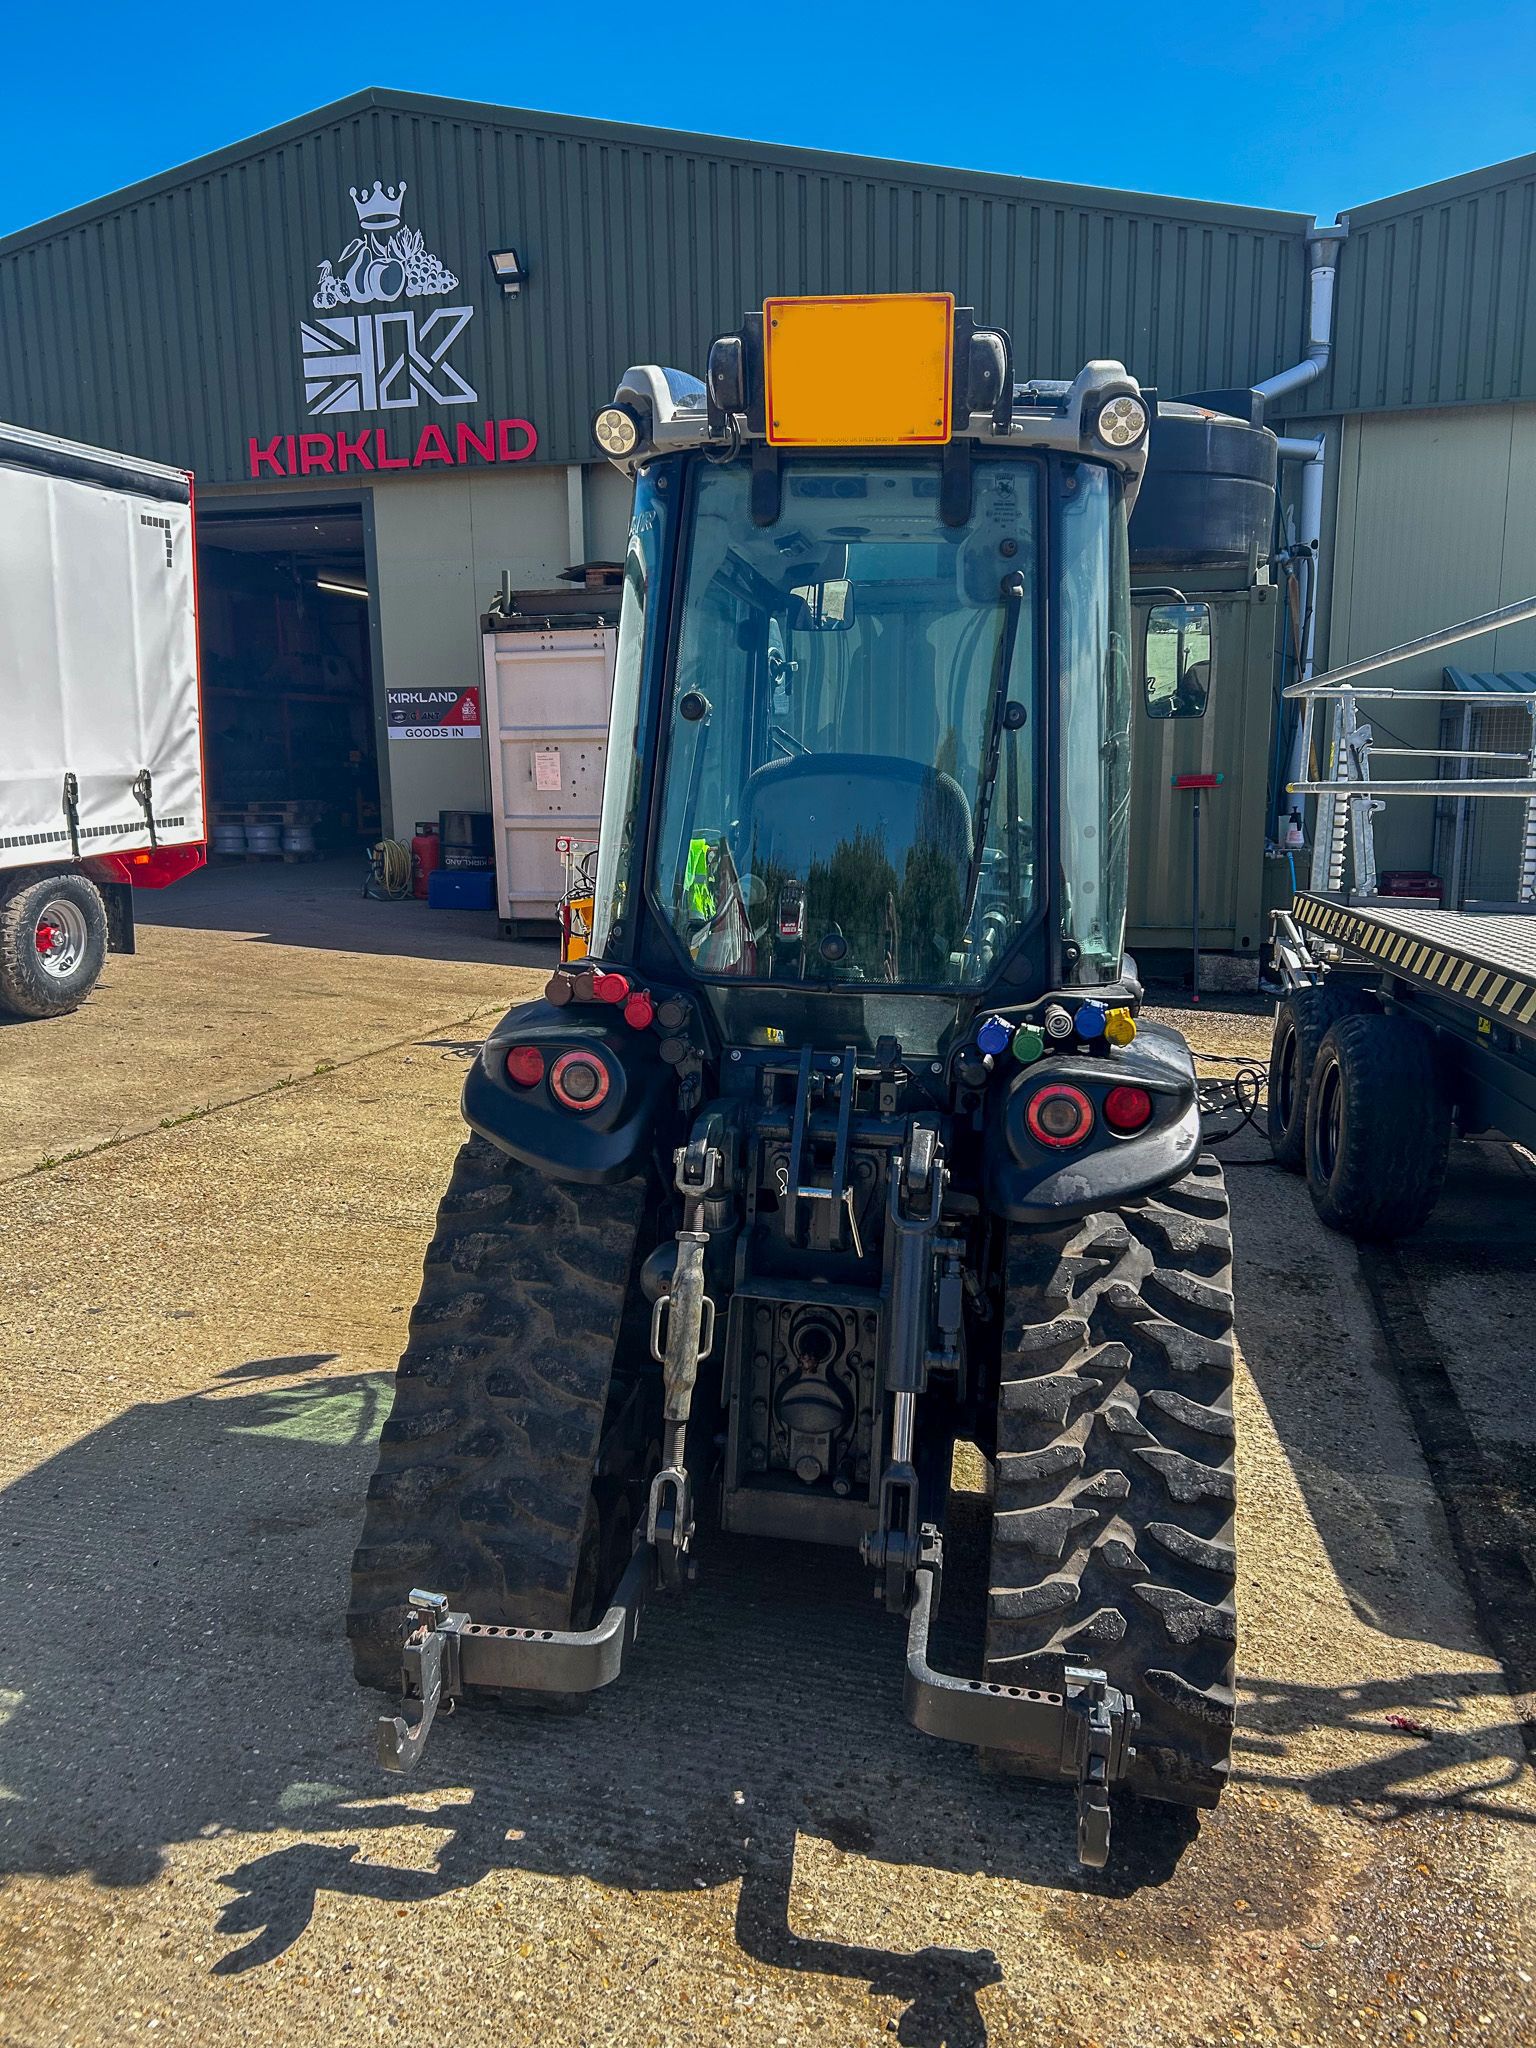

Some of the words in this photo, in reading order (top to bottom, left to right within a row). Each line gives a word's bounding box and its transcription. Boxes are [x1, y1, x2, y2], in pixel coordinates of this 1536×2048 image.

[248, 418, 538, 478] KIRKLAND
[388, 692, 458, 703] KIRKLAND
[405, 728, 449, 737] GOODS
[452, 728, 464, 737] IN
